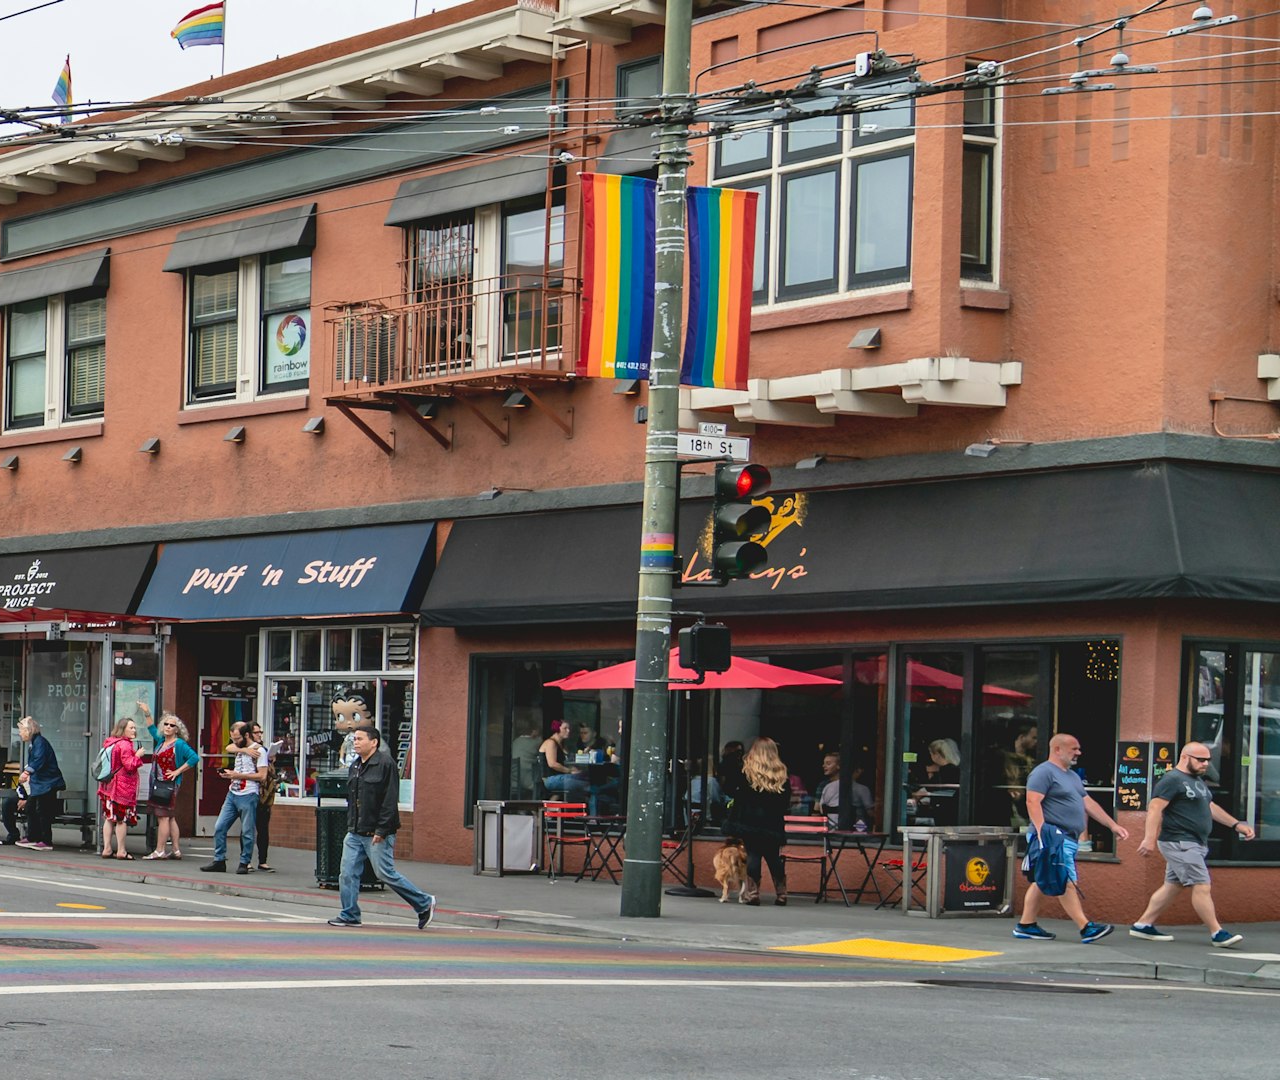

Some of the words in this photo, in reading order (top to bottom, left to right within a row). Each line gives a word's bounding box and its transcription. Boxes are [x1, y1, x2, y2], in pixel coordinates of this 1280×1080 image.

[273, 360, 308, 373] rainbow
[703, 425, 718, 434] 4100
[690, 439, 713, 452] 18th
[719, 441, 733, 454] St
[182, 564, 248, 595] Puff
[297, 557, 378, 588] Stuff
[3, 597, 37, 609] JUICE
[48, 684, 87, 697] PROJ
[61, 702, 87, 722] JUIC
